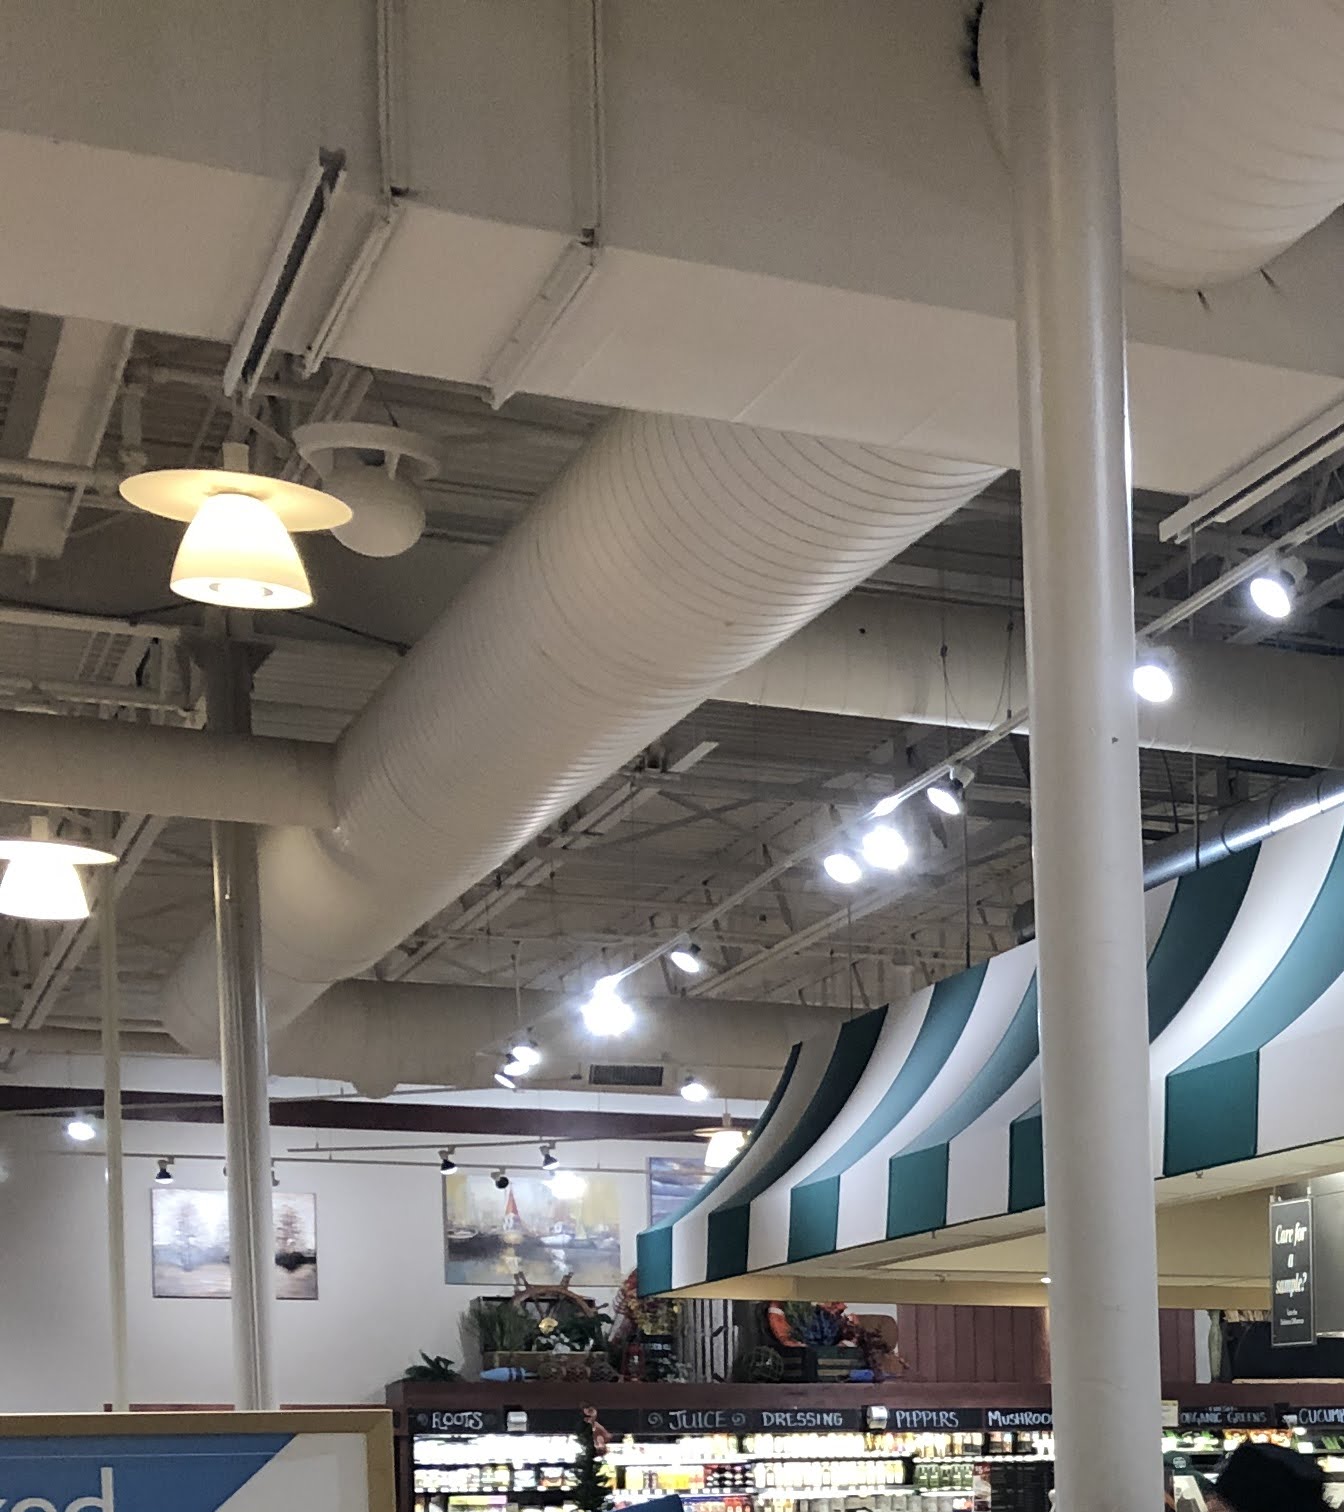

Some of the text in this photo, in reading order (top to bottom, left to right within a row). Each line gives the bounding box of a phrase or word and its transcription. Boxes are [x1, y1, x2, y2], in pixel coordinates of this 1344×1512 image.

[1292, 1222, 1307, 1247] for
[1287, 1253, 1294, 1268] a
[1275, 1272, 1308, 1297] sample?
[432, 1411, 484, 1429] ROOTS
[668, 1410, 727, 1430] JUICE
[762, 1411, 843, 1427] DRESSING
[987, 1411, 1052, 1426] MUSHROO
